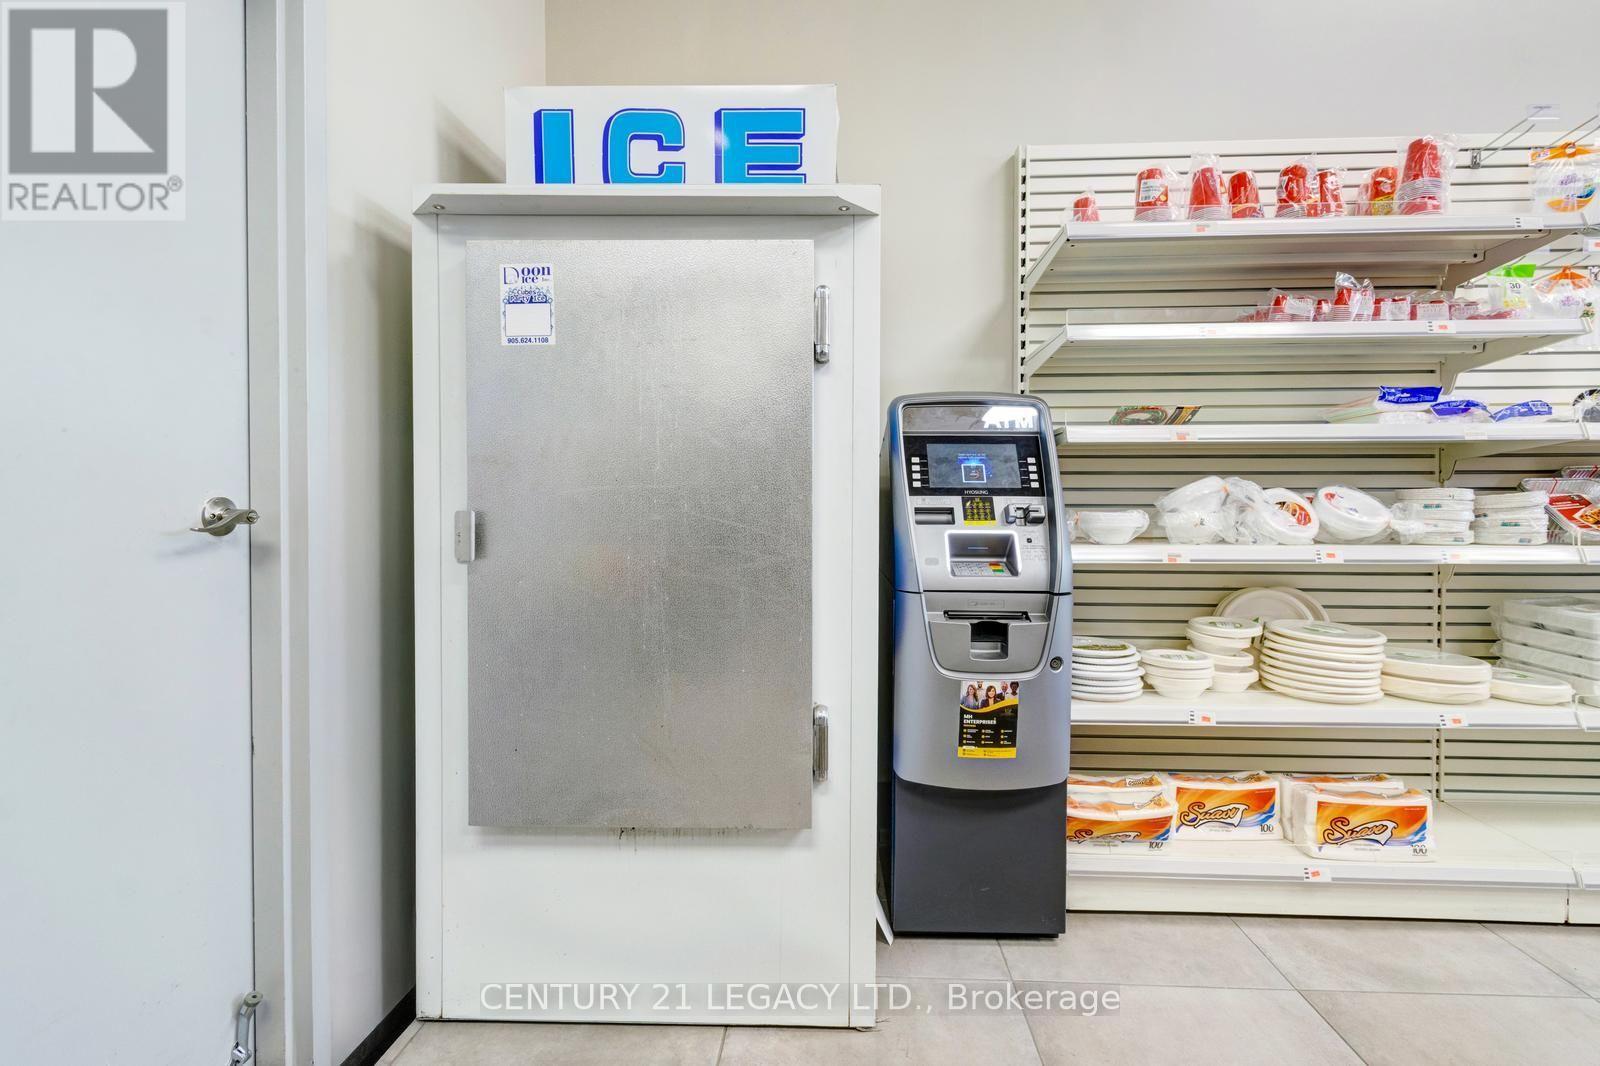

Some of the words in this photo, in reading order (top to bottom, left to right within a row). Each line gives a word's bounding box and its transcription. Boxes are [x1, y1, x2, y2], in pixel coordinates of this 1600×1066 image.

[533, 108, 806, 184] ICE
[503, 266, 552, 285] Doon
[983, 413, 1034, 429] ATM
[1260, 824, 1274, 833] 100
[1149, 841, 1164, 849] 100
[1412, 846, 1428, 855] 100
